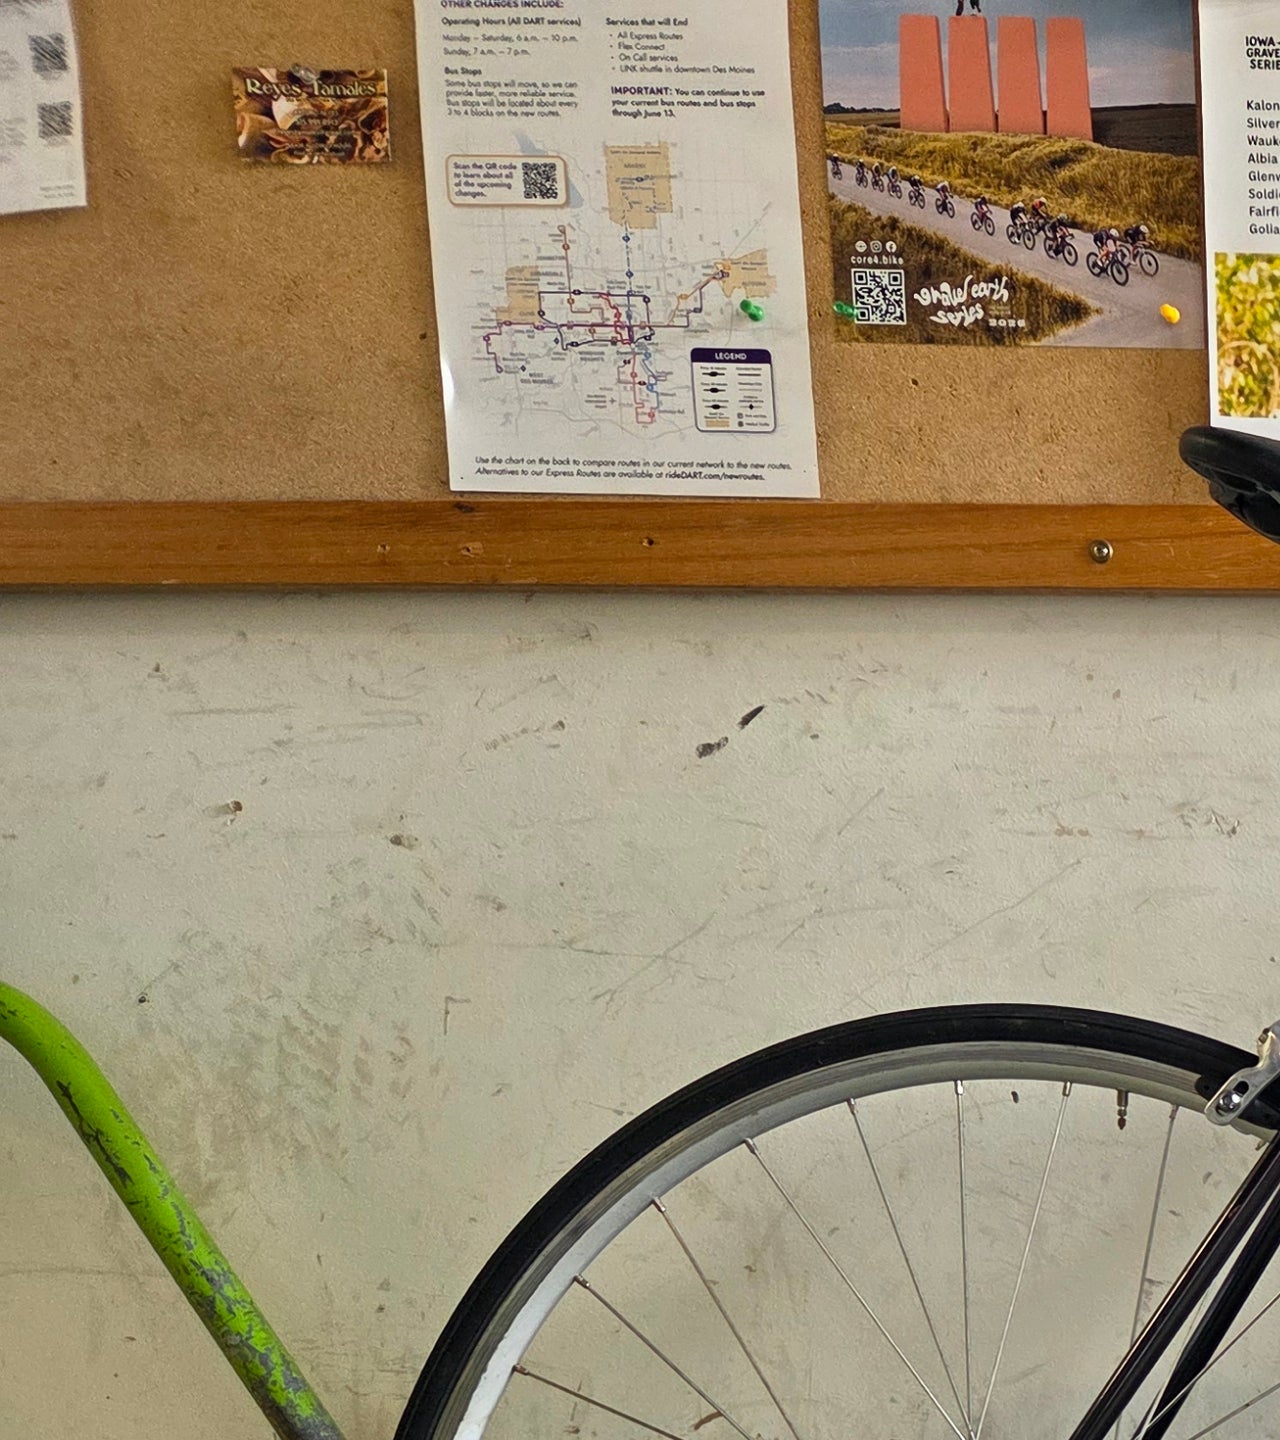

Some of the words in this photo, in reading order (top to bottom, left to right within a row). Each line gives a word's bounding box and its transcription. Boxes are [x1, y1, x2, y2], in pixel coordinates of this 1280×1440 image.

[606, 18, 639, 26] Services
[640, 18, 655, 26] that
[657, 18, 671, 26] will
[672, 18, 688, 26] End
[1245, 36, 1276, 47] IOWA
[444, 66, 458, 75] Bus
[460, 67, 482, 77] Stops
[245, 78, 302, 99] Reyes
[310, 79, 377, 97] Tamales
[610, 86, 672, 96] IMPORTANT:
[674, 87, 688, 96] You
[706, 87, 740, 96] continue
[1246, 118, 1280, 130] Silver
[1247, 154, 1278, 165] Albia
[850, 255, 904, 265] core4.bike
[475, 466, 519, 475] Alternatives
[545, 467, 574, 478] Express
[575, 468, 601, 477] Routes
[617, 469, 653, 478] available
[665, 469, 766, 480] rideDART.com/newroutes.
